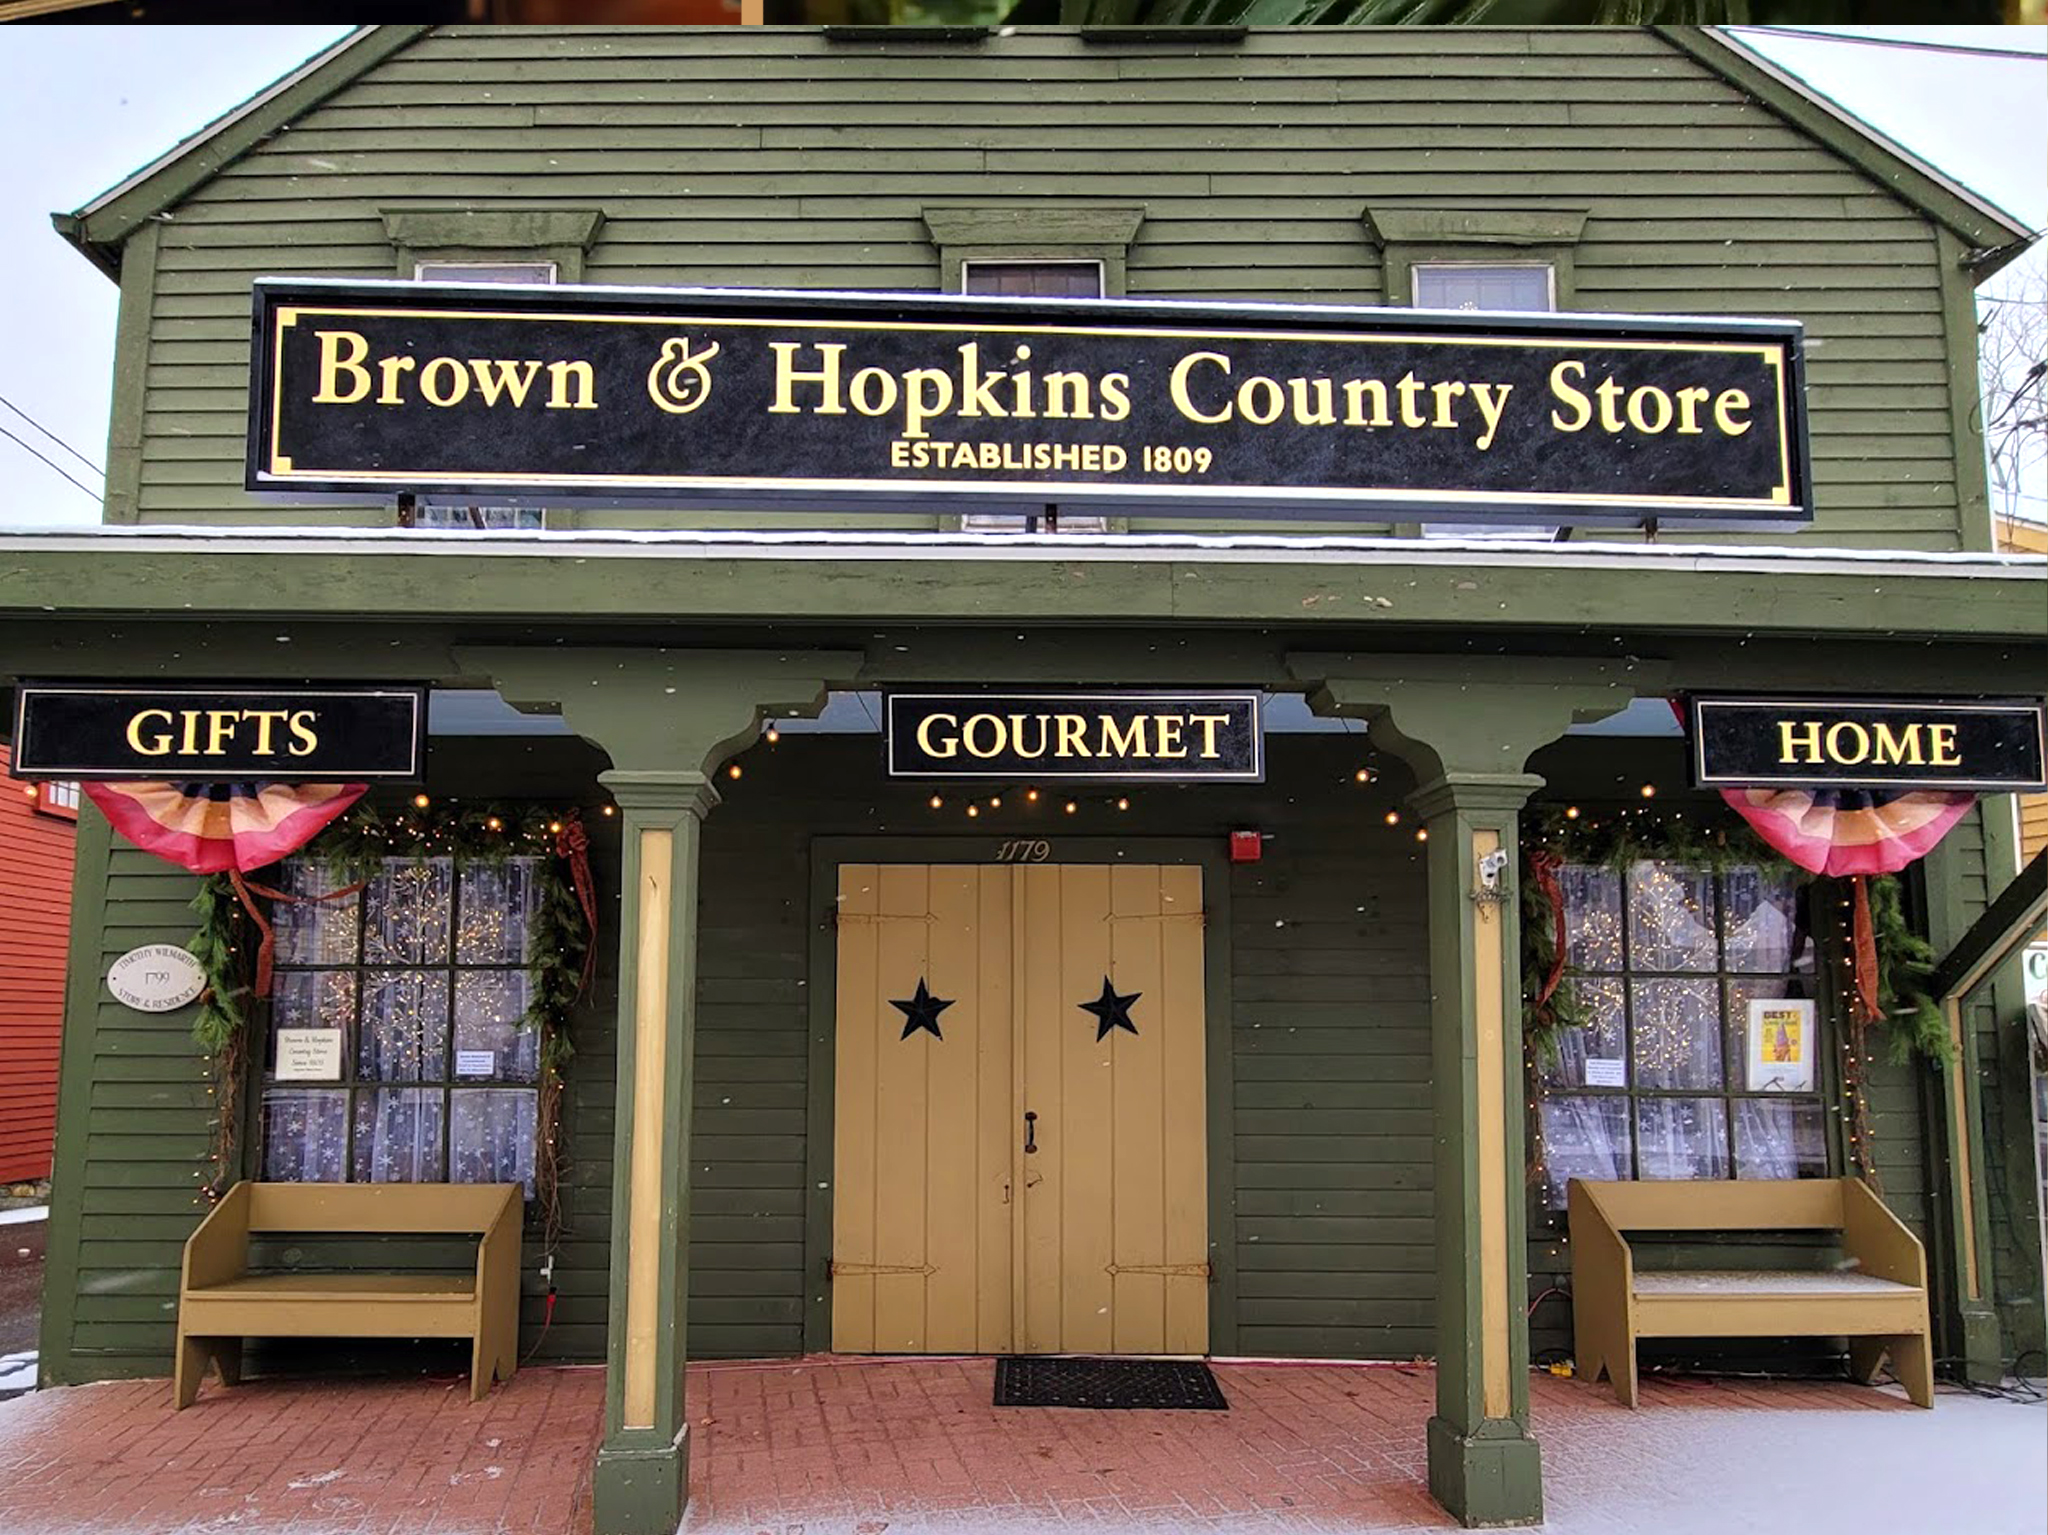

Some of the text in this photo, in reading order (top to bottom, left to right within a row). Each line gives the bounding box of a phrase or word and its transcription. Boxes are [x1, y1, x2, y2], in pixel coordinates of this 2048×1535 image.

[312, 331, 1753, 451] Brown & Hopkins Country Store
[890, 441, 1213, 474] ESTABLISHED 1809
[126, 708, 319, 757] GIFTS
[916, 713, 1230, 759] GOURMET
[1777, 720, 1963, 767] HOME
[996, 840, 1050, 862] 1179
[145, 972, 170, 985] 1799
